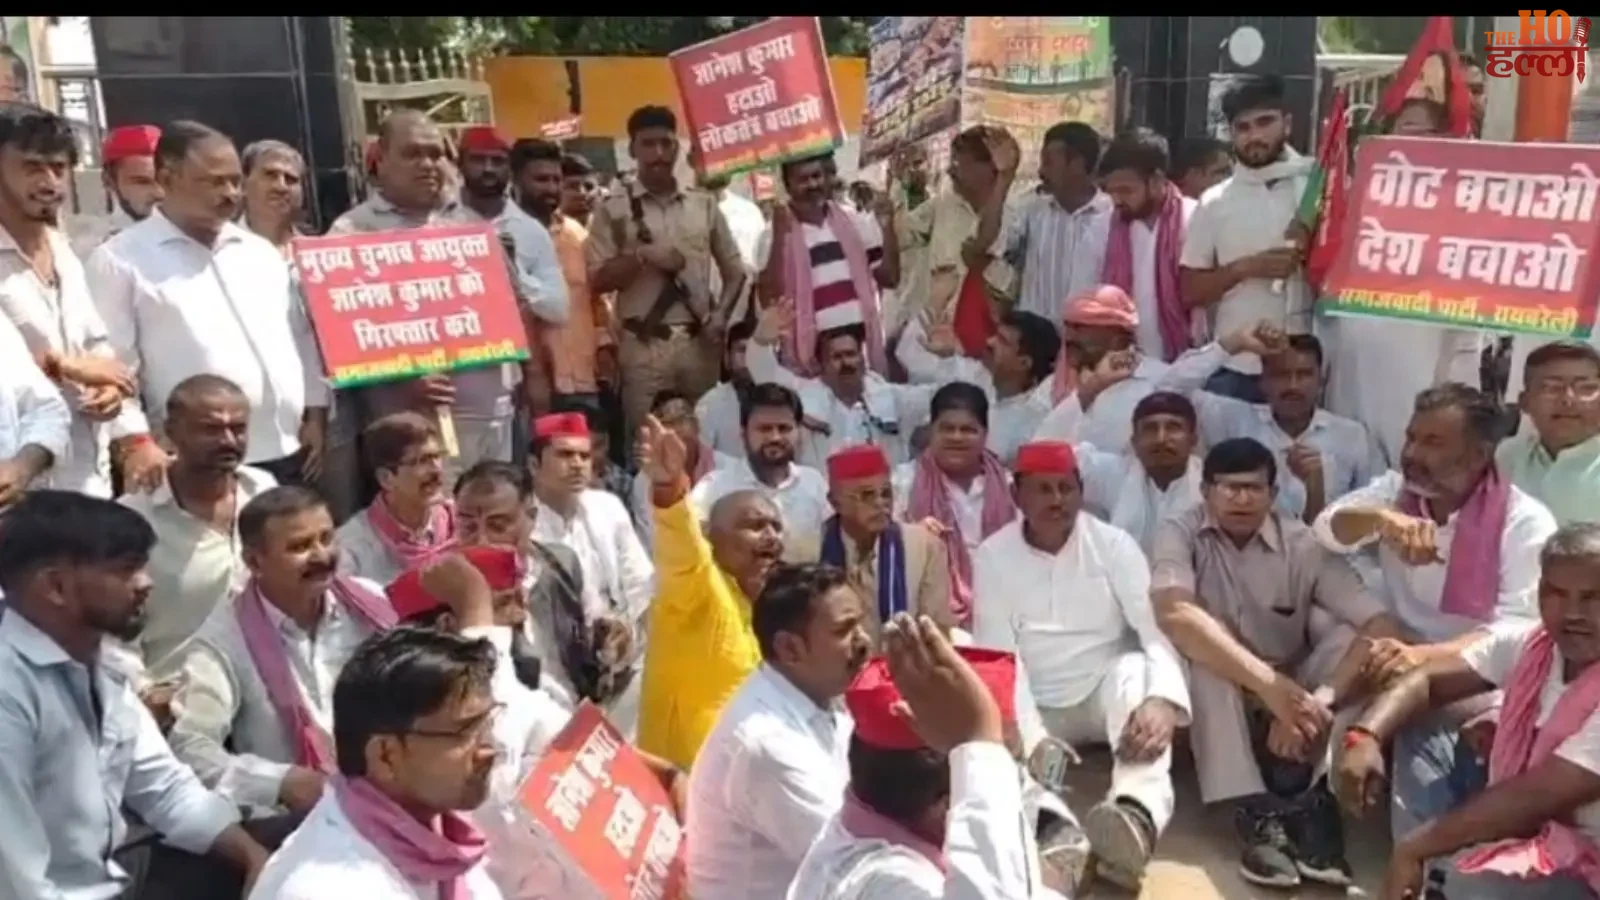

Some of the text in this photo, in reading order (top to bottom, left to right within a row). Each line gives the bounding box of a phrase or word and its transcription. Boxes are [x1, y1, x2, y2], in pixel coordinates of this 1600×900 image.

[746, 34, 796, 75] कुमार
[1368, 150, 1448, 209] वोट
[1455, 162, 1600, 222] बचाओ
[297, 233, 490, 284] मुख्य चुनाव आयुक्त
[1357, 216, 1588, 292] देश बचाओ
[397, 276, 454, 312] कुमार
[456, 267, 486, 297] को
[1338, 287, 1432, 313] समाजवादी
[443, 306, 482, 338] करो
